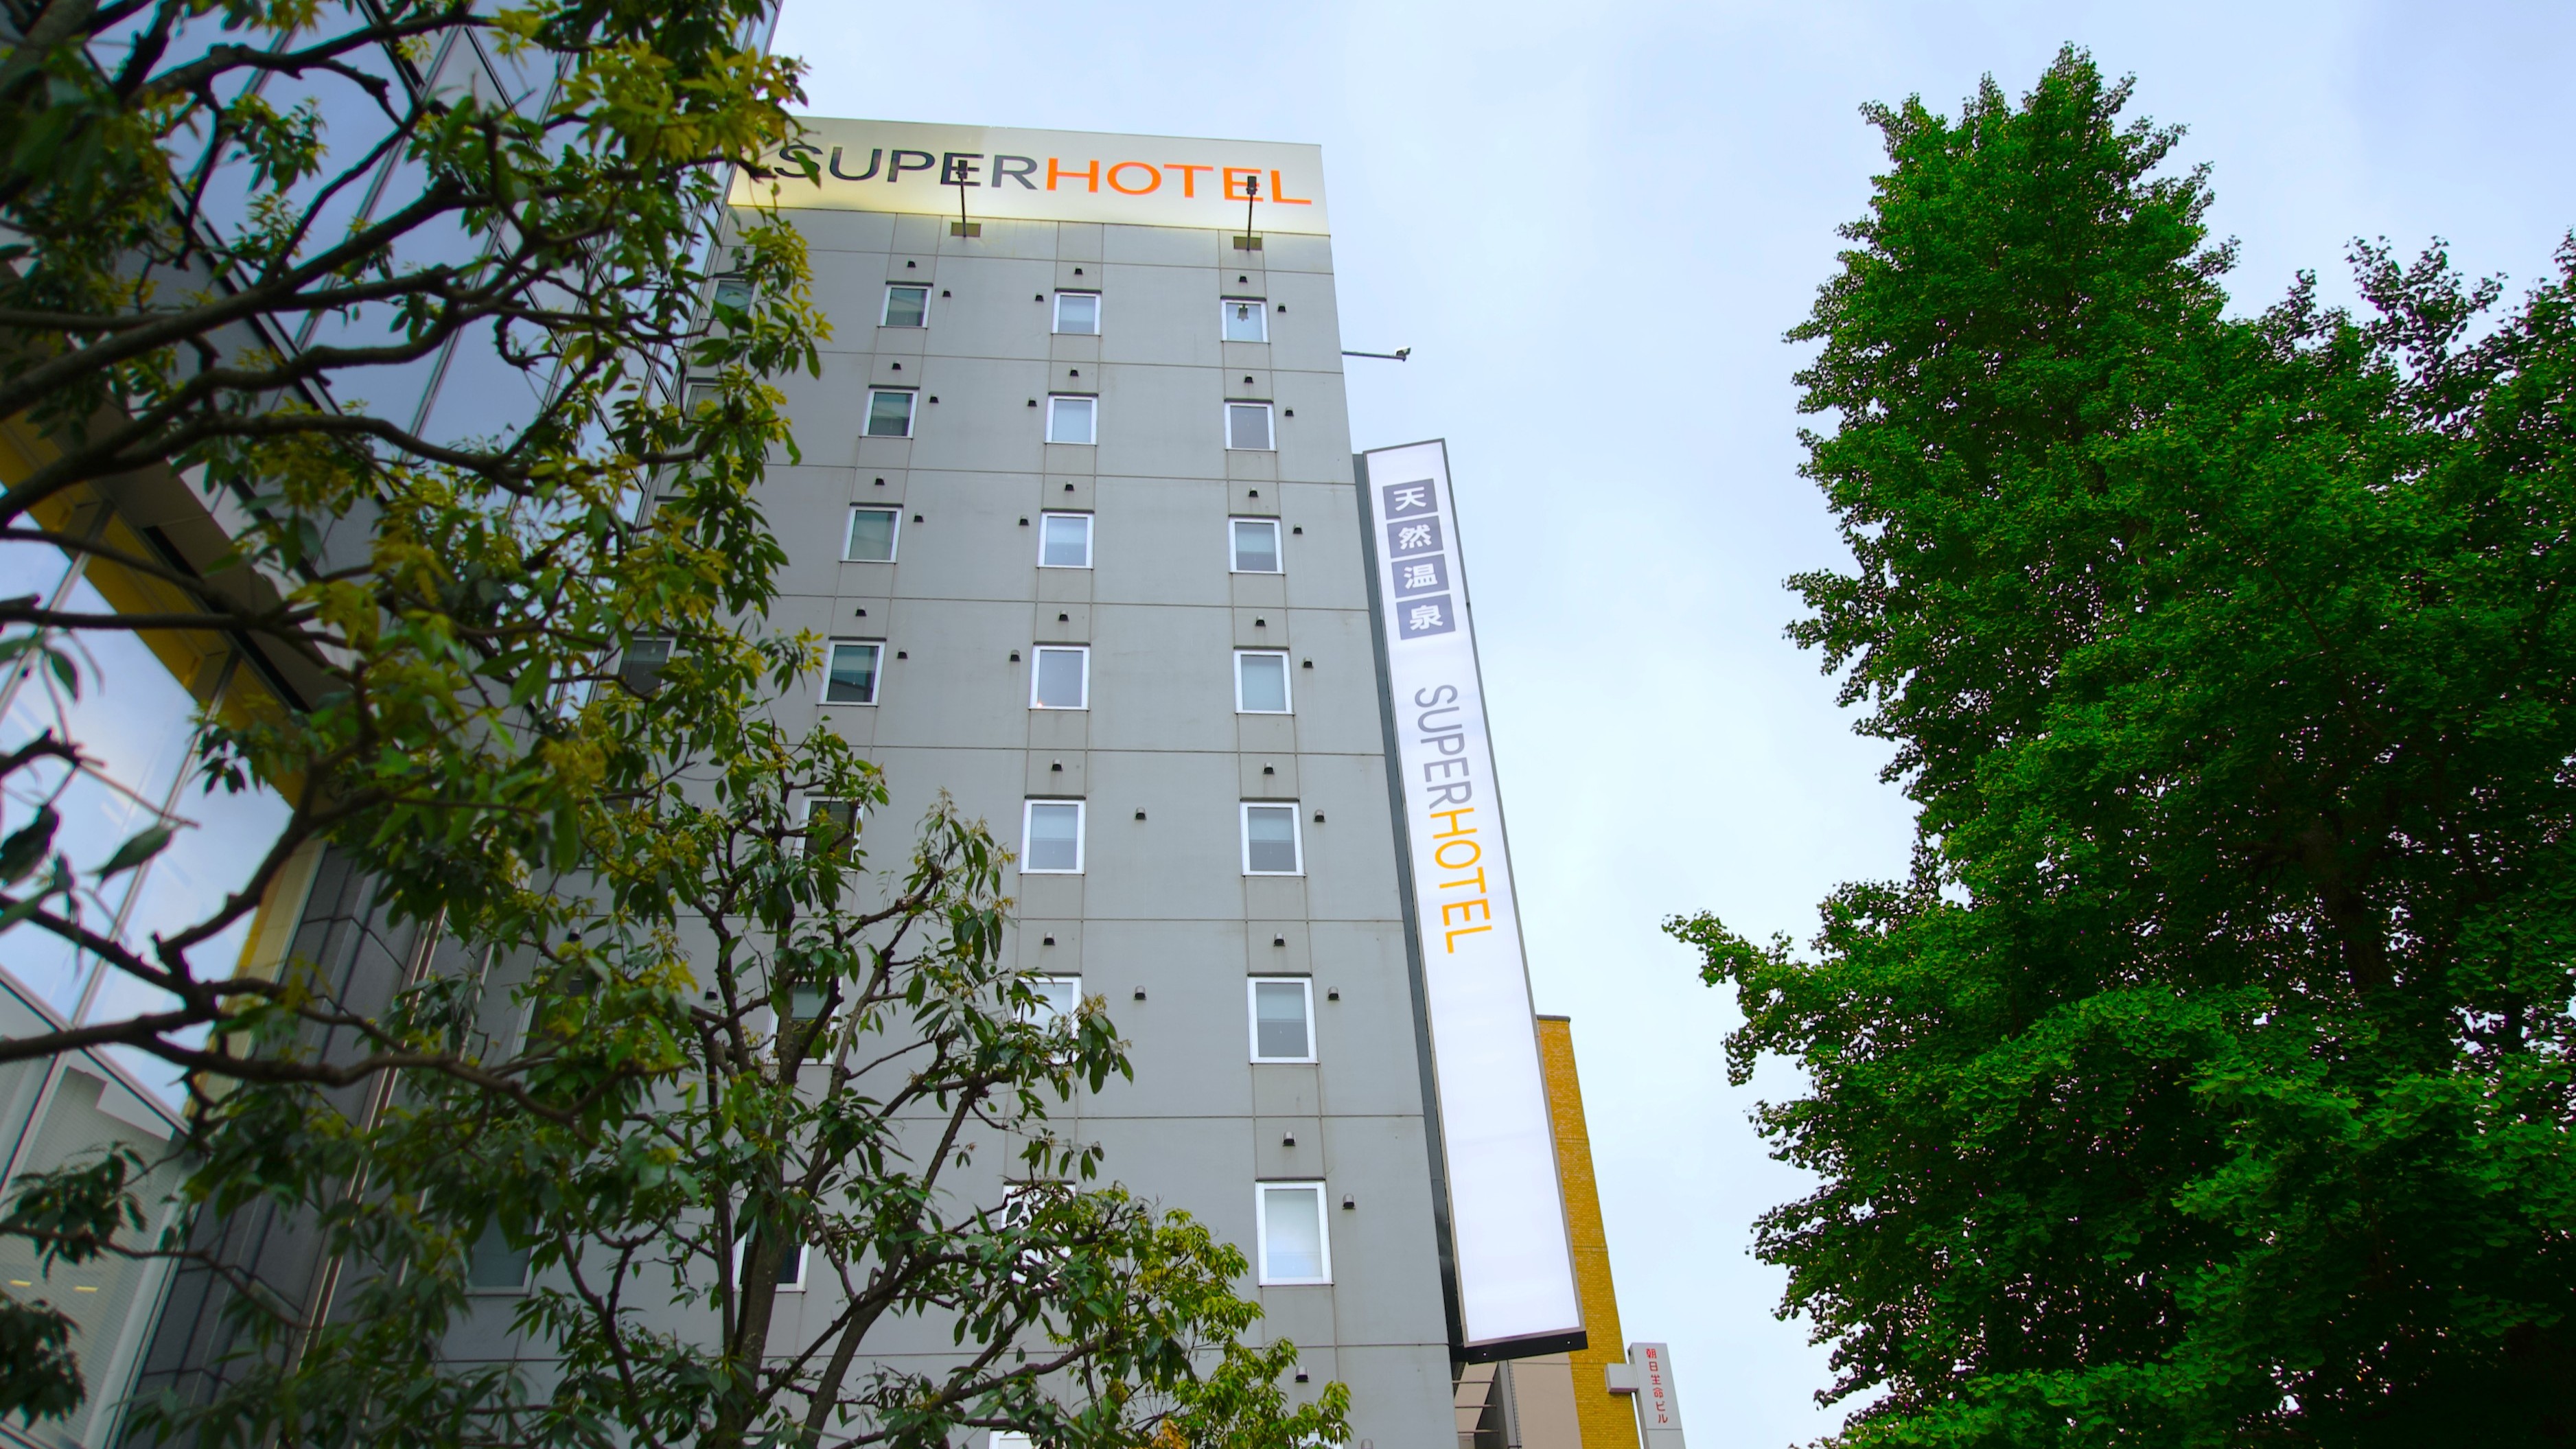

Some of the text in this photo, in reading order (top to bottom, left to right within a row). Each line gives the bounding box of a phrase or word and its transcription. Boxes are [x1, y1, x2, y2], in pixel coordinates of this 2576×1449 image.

[1393, 486, 1443, 631] 天然温泉
[1415, 684, 1493, 954] SUPERHOTEL
[1646, 1348, 1669, 1424] 朝日生命ビル
